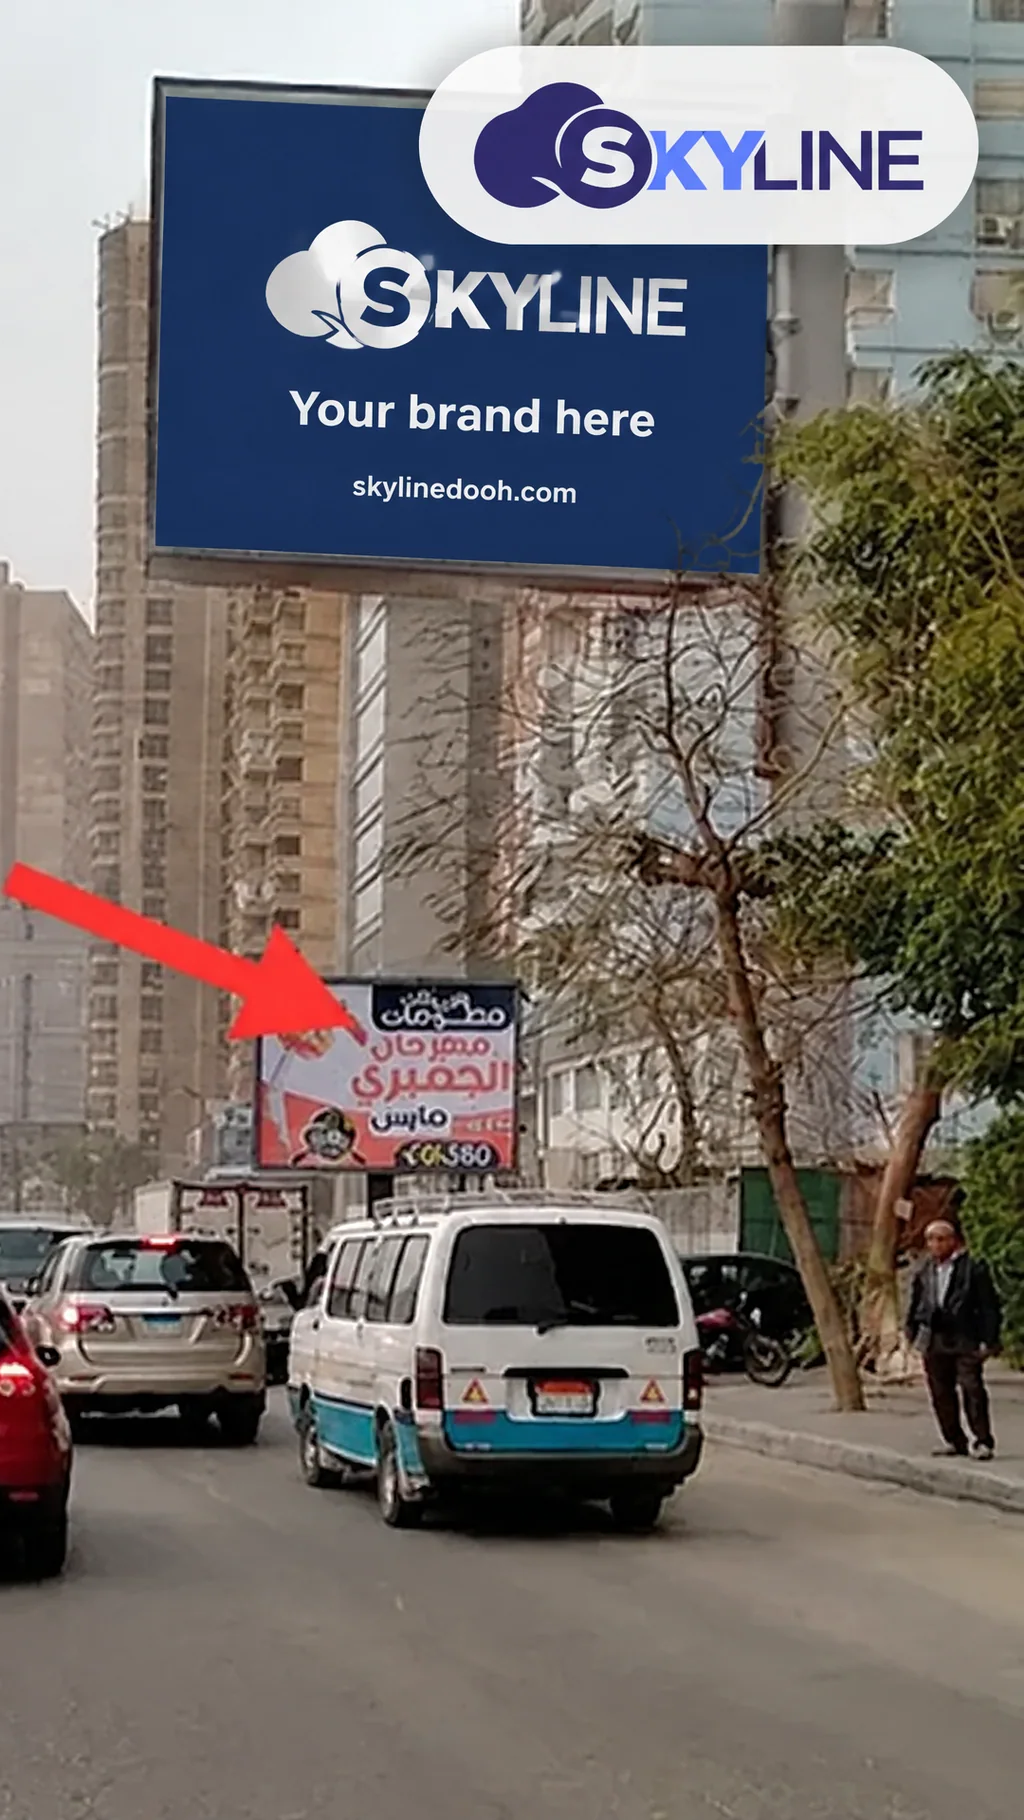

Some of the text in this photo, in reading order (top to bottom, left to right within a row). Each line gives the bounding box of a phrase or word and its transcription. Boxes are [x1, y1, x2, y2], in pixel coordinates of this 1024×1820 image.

[360, 265, 688, 337] SKYLINE
[289, 391, 655, 438] Your brand here
[352, 475, 577, 504] skylinedooh.com
[372, 1036, 490, 1063] مهرجان
[352, 1061, 509, 1107] الجمبري
